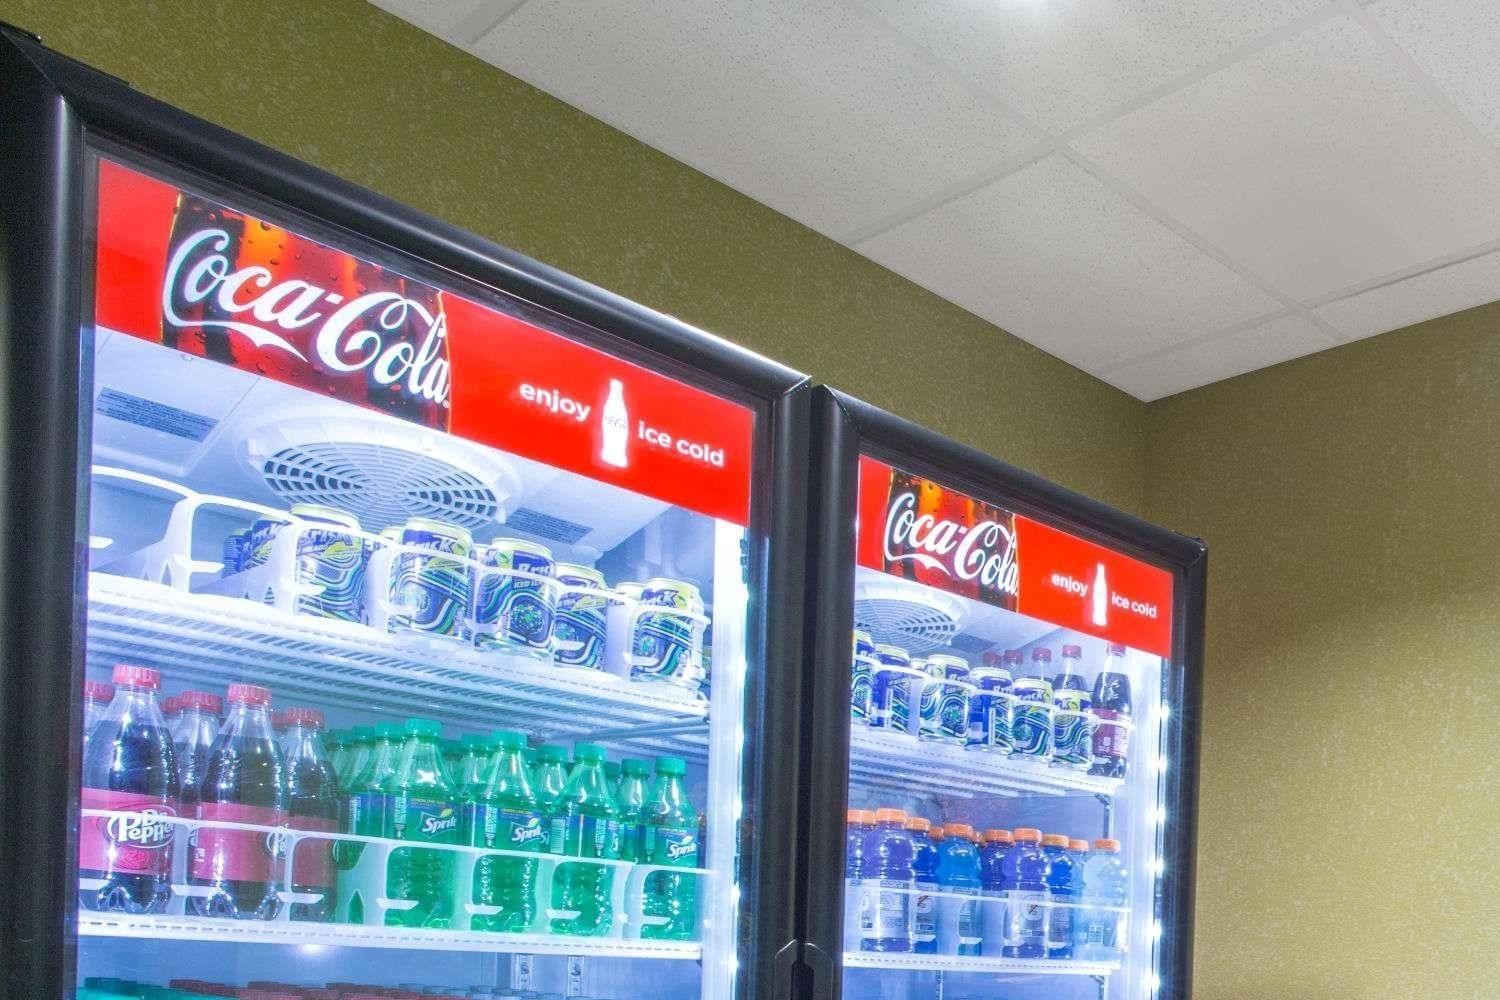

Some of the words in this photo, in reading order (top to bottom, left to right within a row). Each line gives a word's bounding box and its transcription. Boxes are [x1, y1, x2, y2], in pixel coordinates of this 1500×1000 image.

[161, 228, 451, 406] Coca-Cola
[519, 381, 591, 422] enjoy
[675, 437, 725, 468] cold
[884, 493, 1018, 596] Coca-Cola
[1052, 573, 1088, 598] enjoy
[1132, 598, 1157, 618] cold
